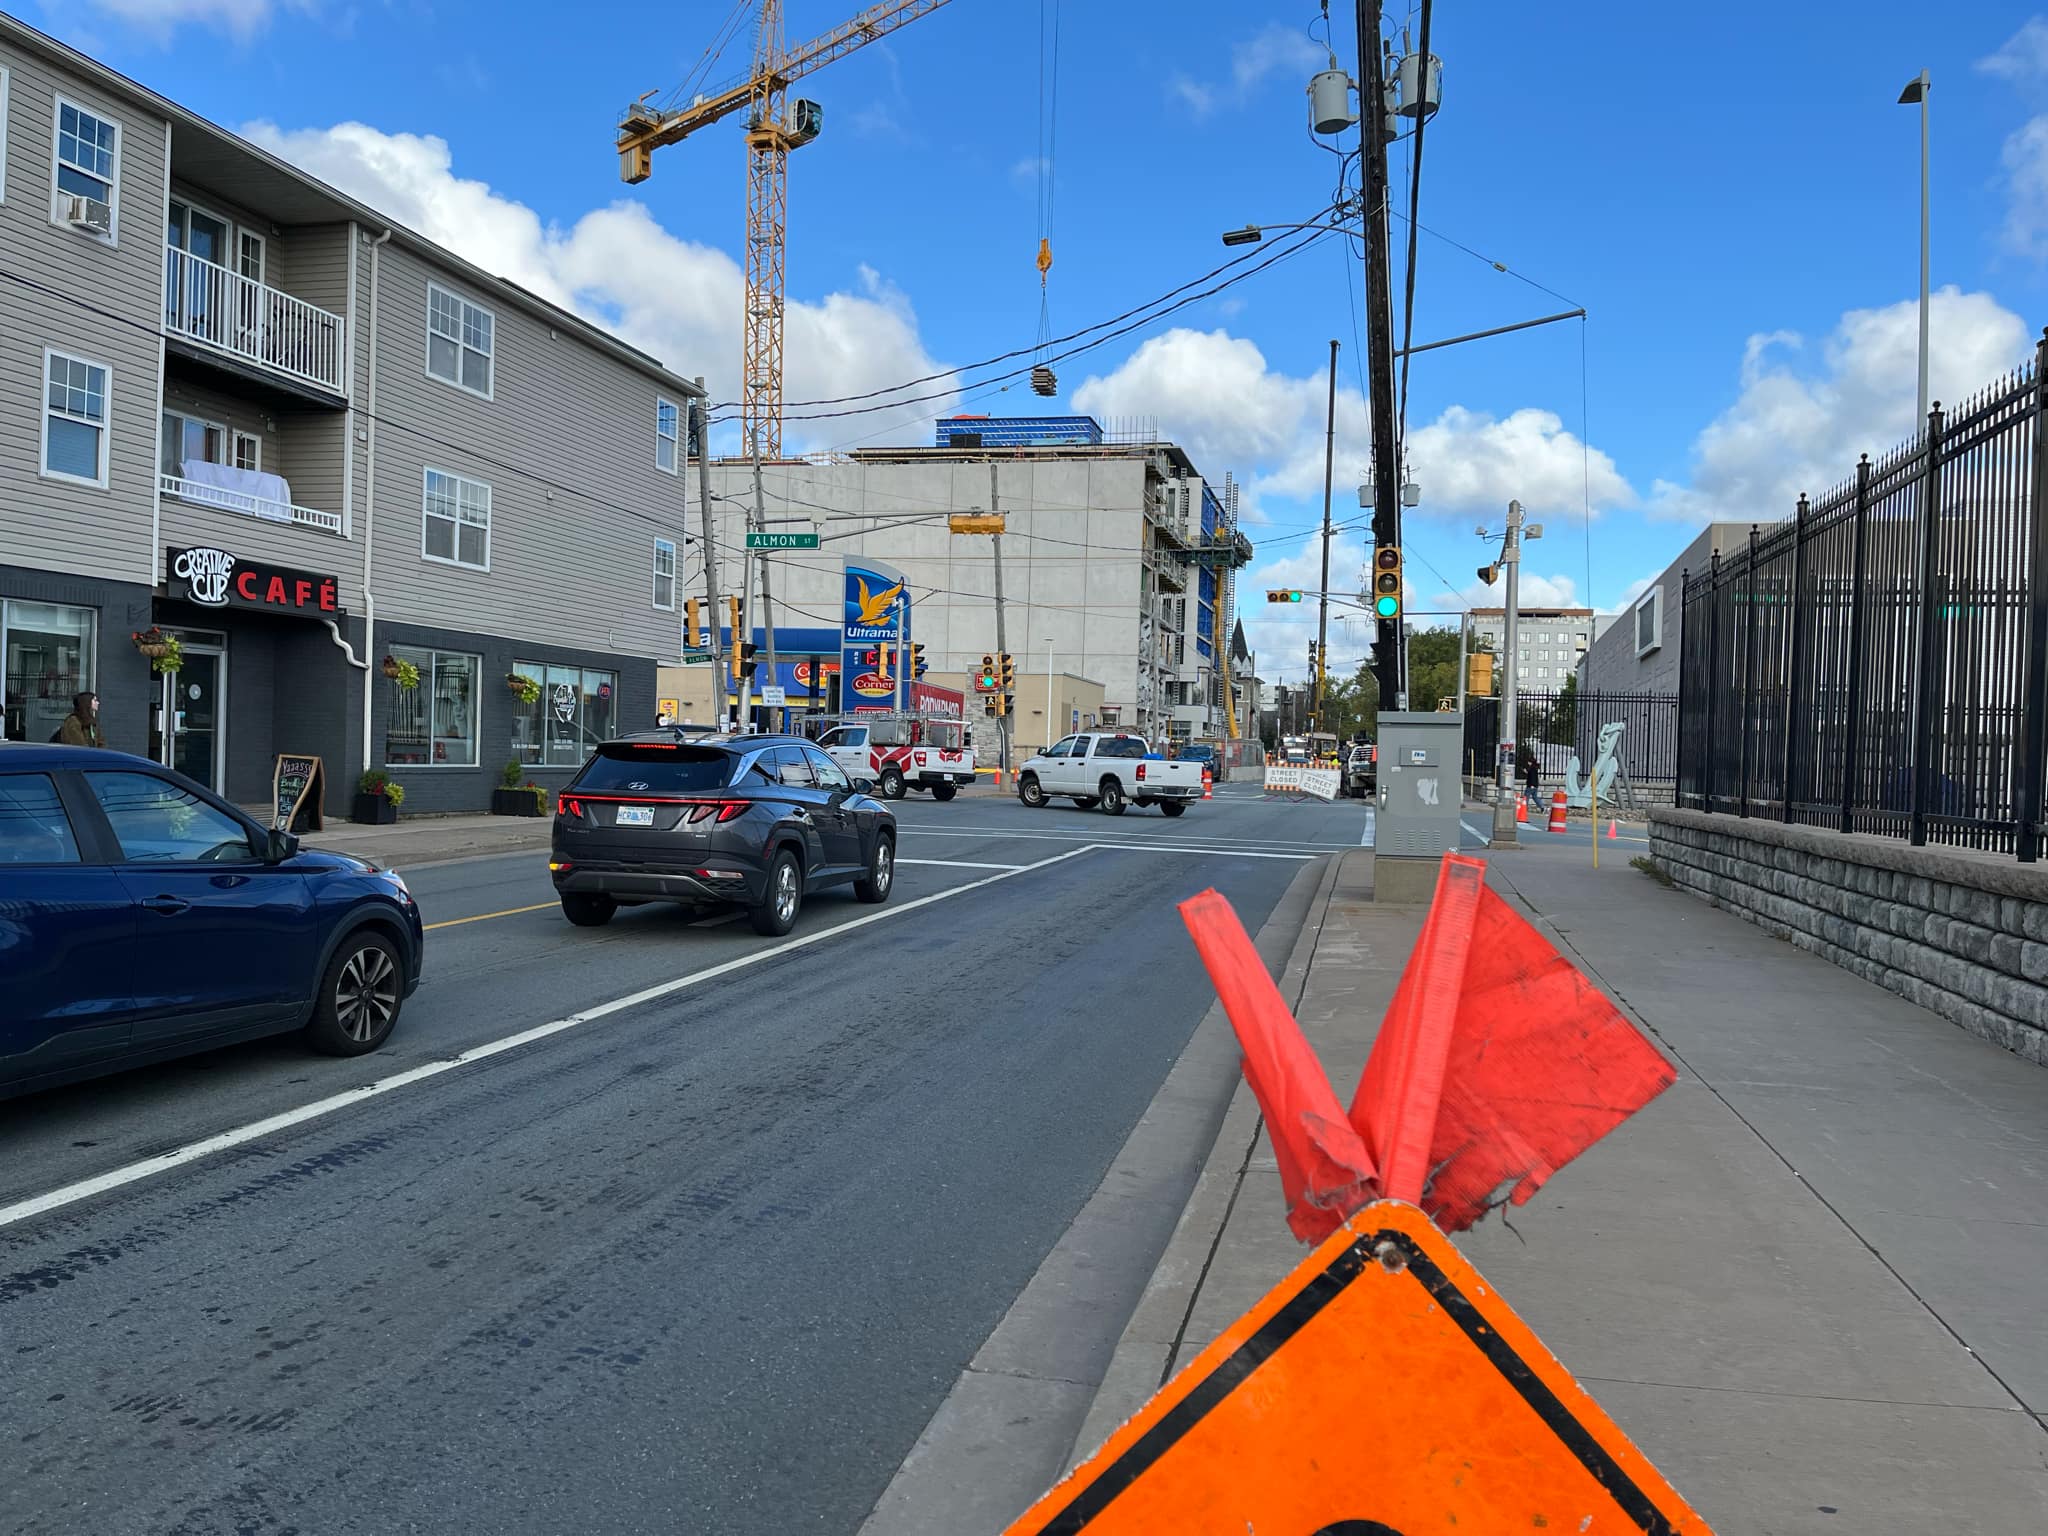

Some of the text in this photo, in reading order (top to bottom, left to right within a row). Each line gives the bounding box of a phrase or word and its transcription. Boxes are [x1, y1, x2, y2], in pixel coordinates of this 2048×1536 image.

[753, 535, 797, 547] ALMON
[174, 548, 236, 580] CREATIVE
[192, 574, 229, 602] CUP
[237, 571, 336, 611] CAFÉ
[847, 627, 899, 638] Ultrama
[855, 679, 894, 689] Corner
[1271, 769, 1297, 777] STREET
[1307, 776, 1333, 788] STREET
[1303, 782, 1331, 795] CLOSED
